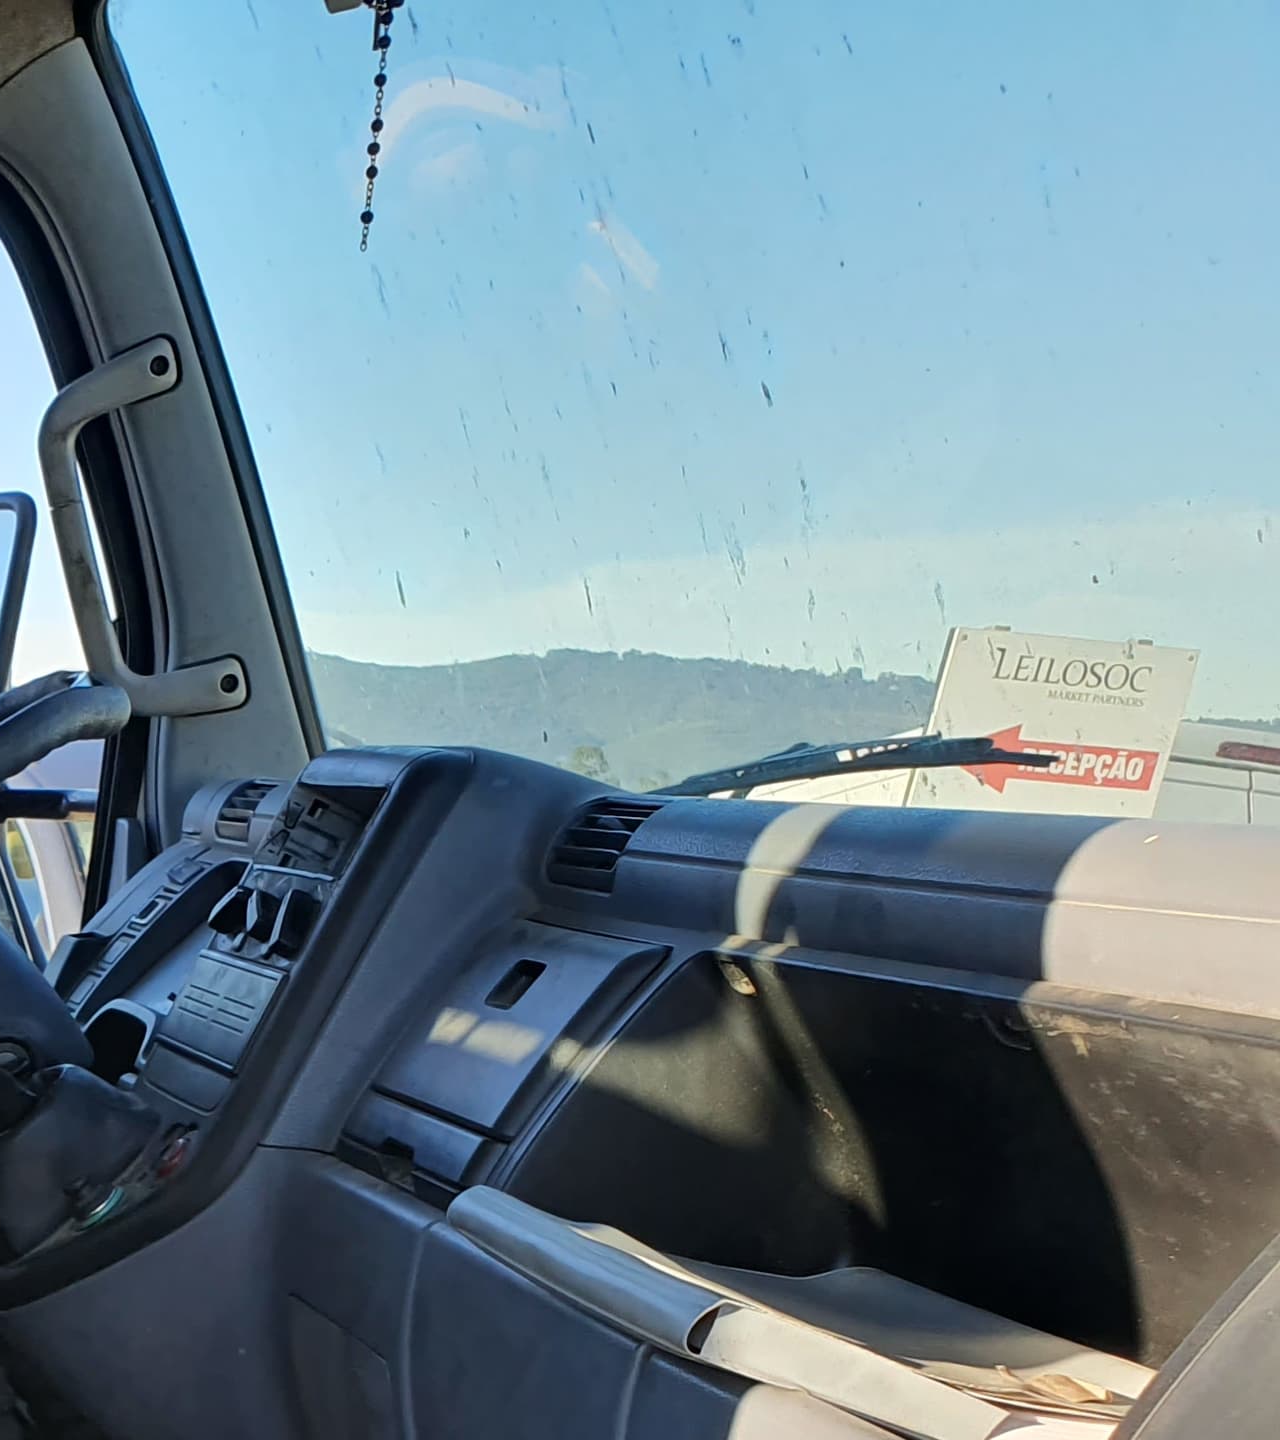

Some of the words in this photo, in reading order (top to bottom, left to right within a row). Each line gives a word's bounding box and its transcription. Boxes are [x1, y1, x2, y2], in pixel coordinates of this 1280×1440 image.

[992, 647, 1153, 693] LEILOSOC
[1047, 689, 1091, 704] MARKET
[1092, 693, 1145, 707] PARTNERS
